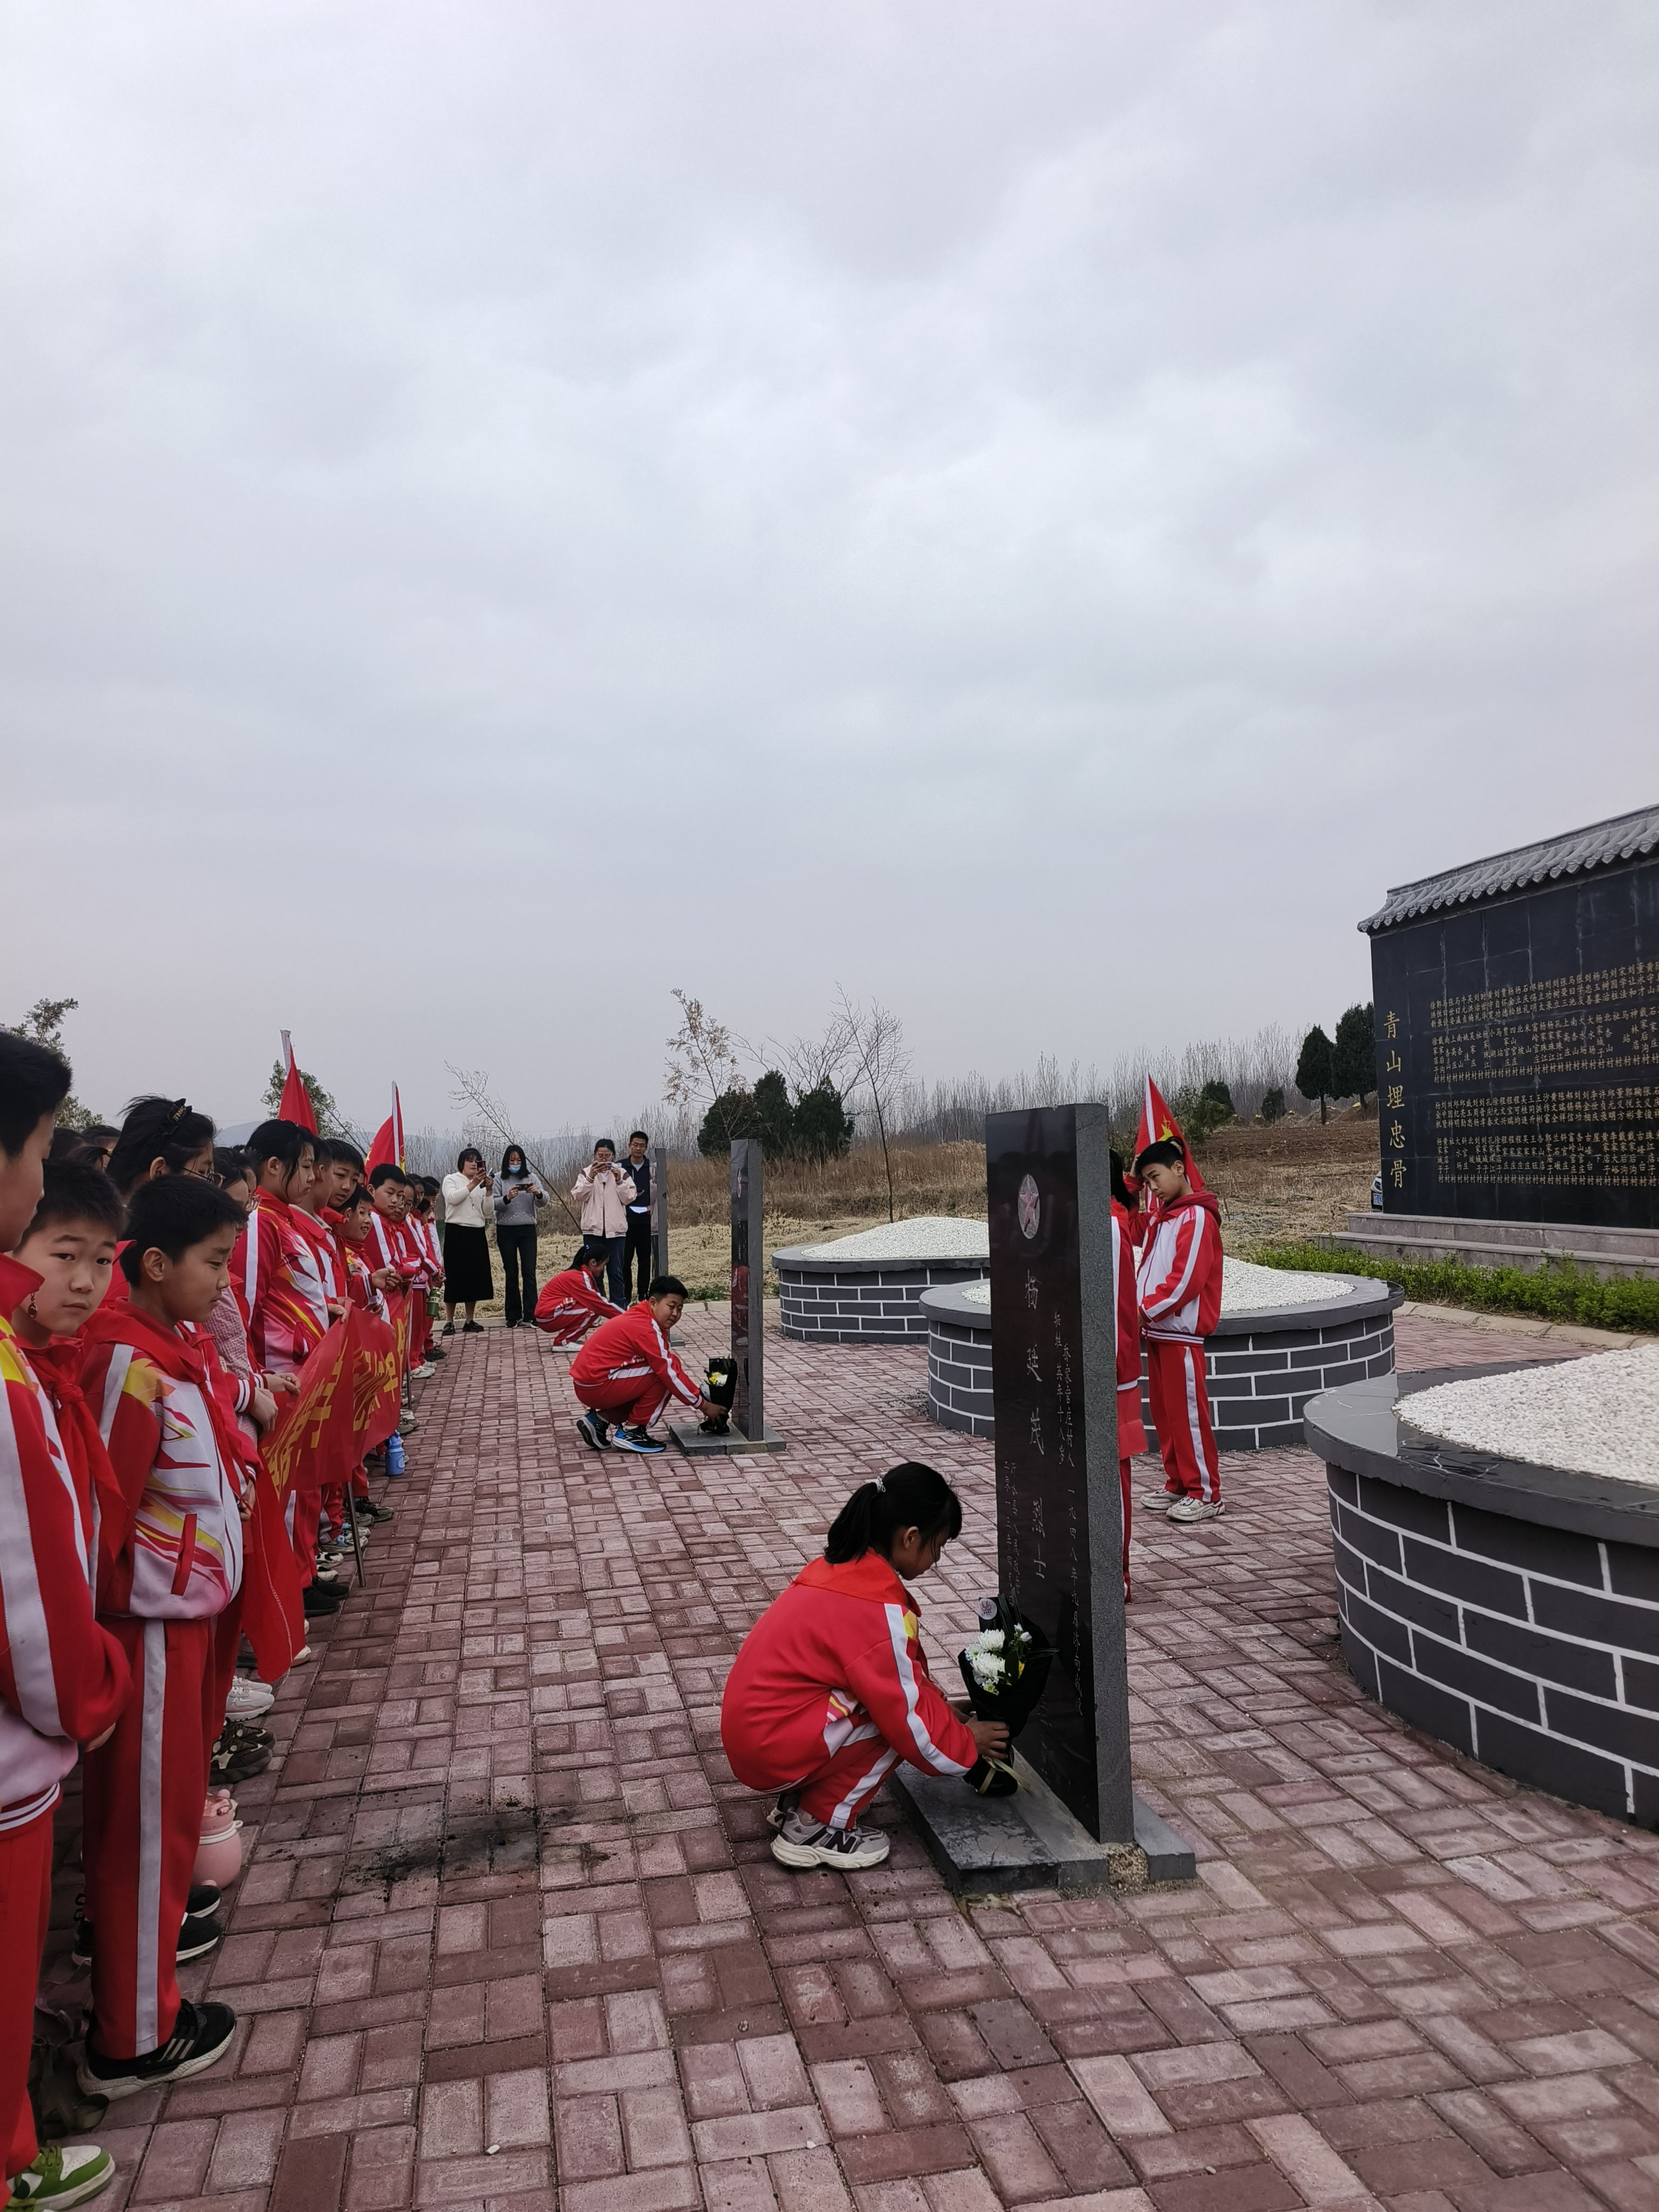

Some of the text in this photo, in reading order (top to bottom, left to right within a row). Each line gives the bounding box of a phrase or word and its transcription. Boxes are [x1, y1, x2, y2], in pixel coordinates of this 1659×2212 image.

[1384, 1011, 1407, 1188] 青山埋忠骨
